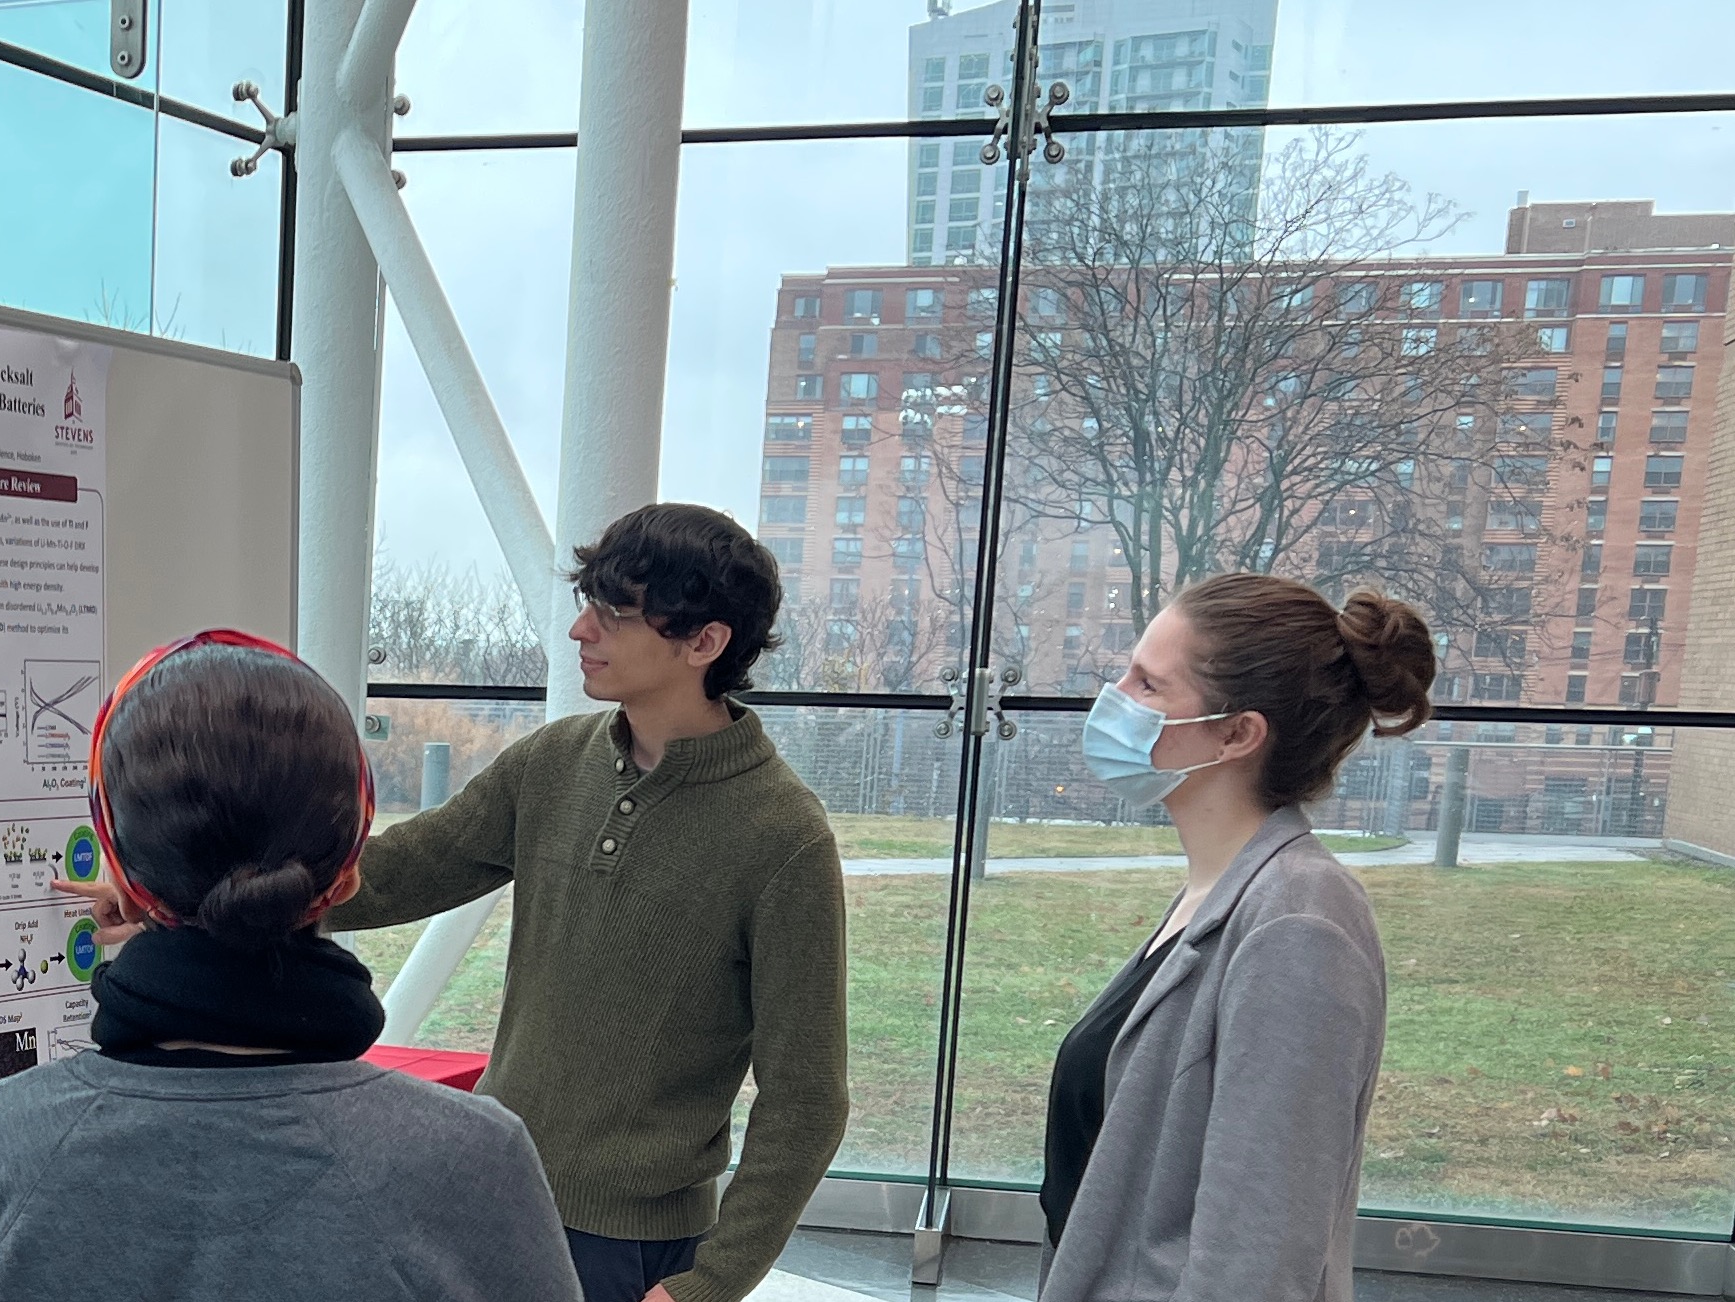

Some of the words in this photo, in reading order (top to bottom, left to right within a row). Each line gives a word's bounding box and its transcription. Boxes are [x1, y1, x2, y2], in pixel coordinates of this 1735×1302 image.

[54, 426, 93, 442] STEVENS
[11, 476, 40, 493] Review
[21, 515, 33, 526] well
[10, 579, 21, 591] high
[7, 623, 27, 635] method
[14, 921, 25, 931] Drip
[27, 920, 38, 930] Add
[65, 999, 88, 1010] Capacity
[15, 1030, 36, 1050] Mn
